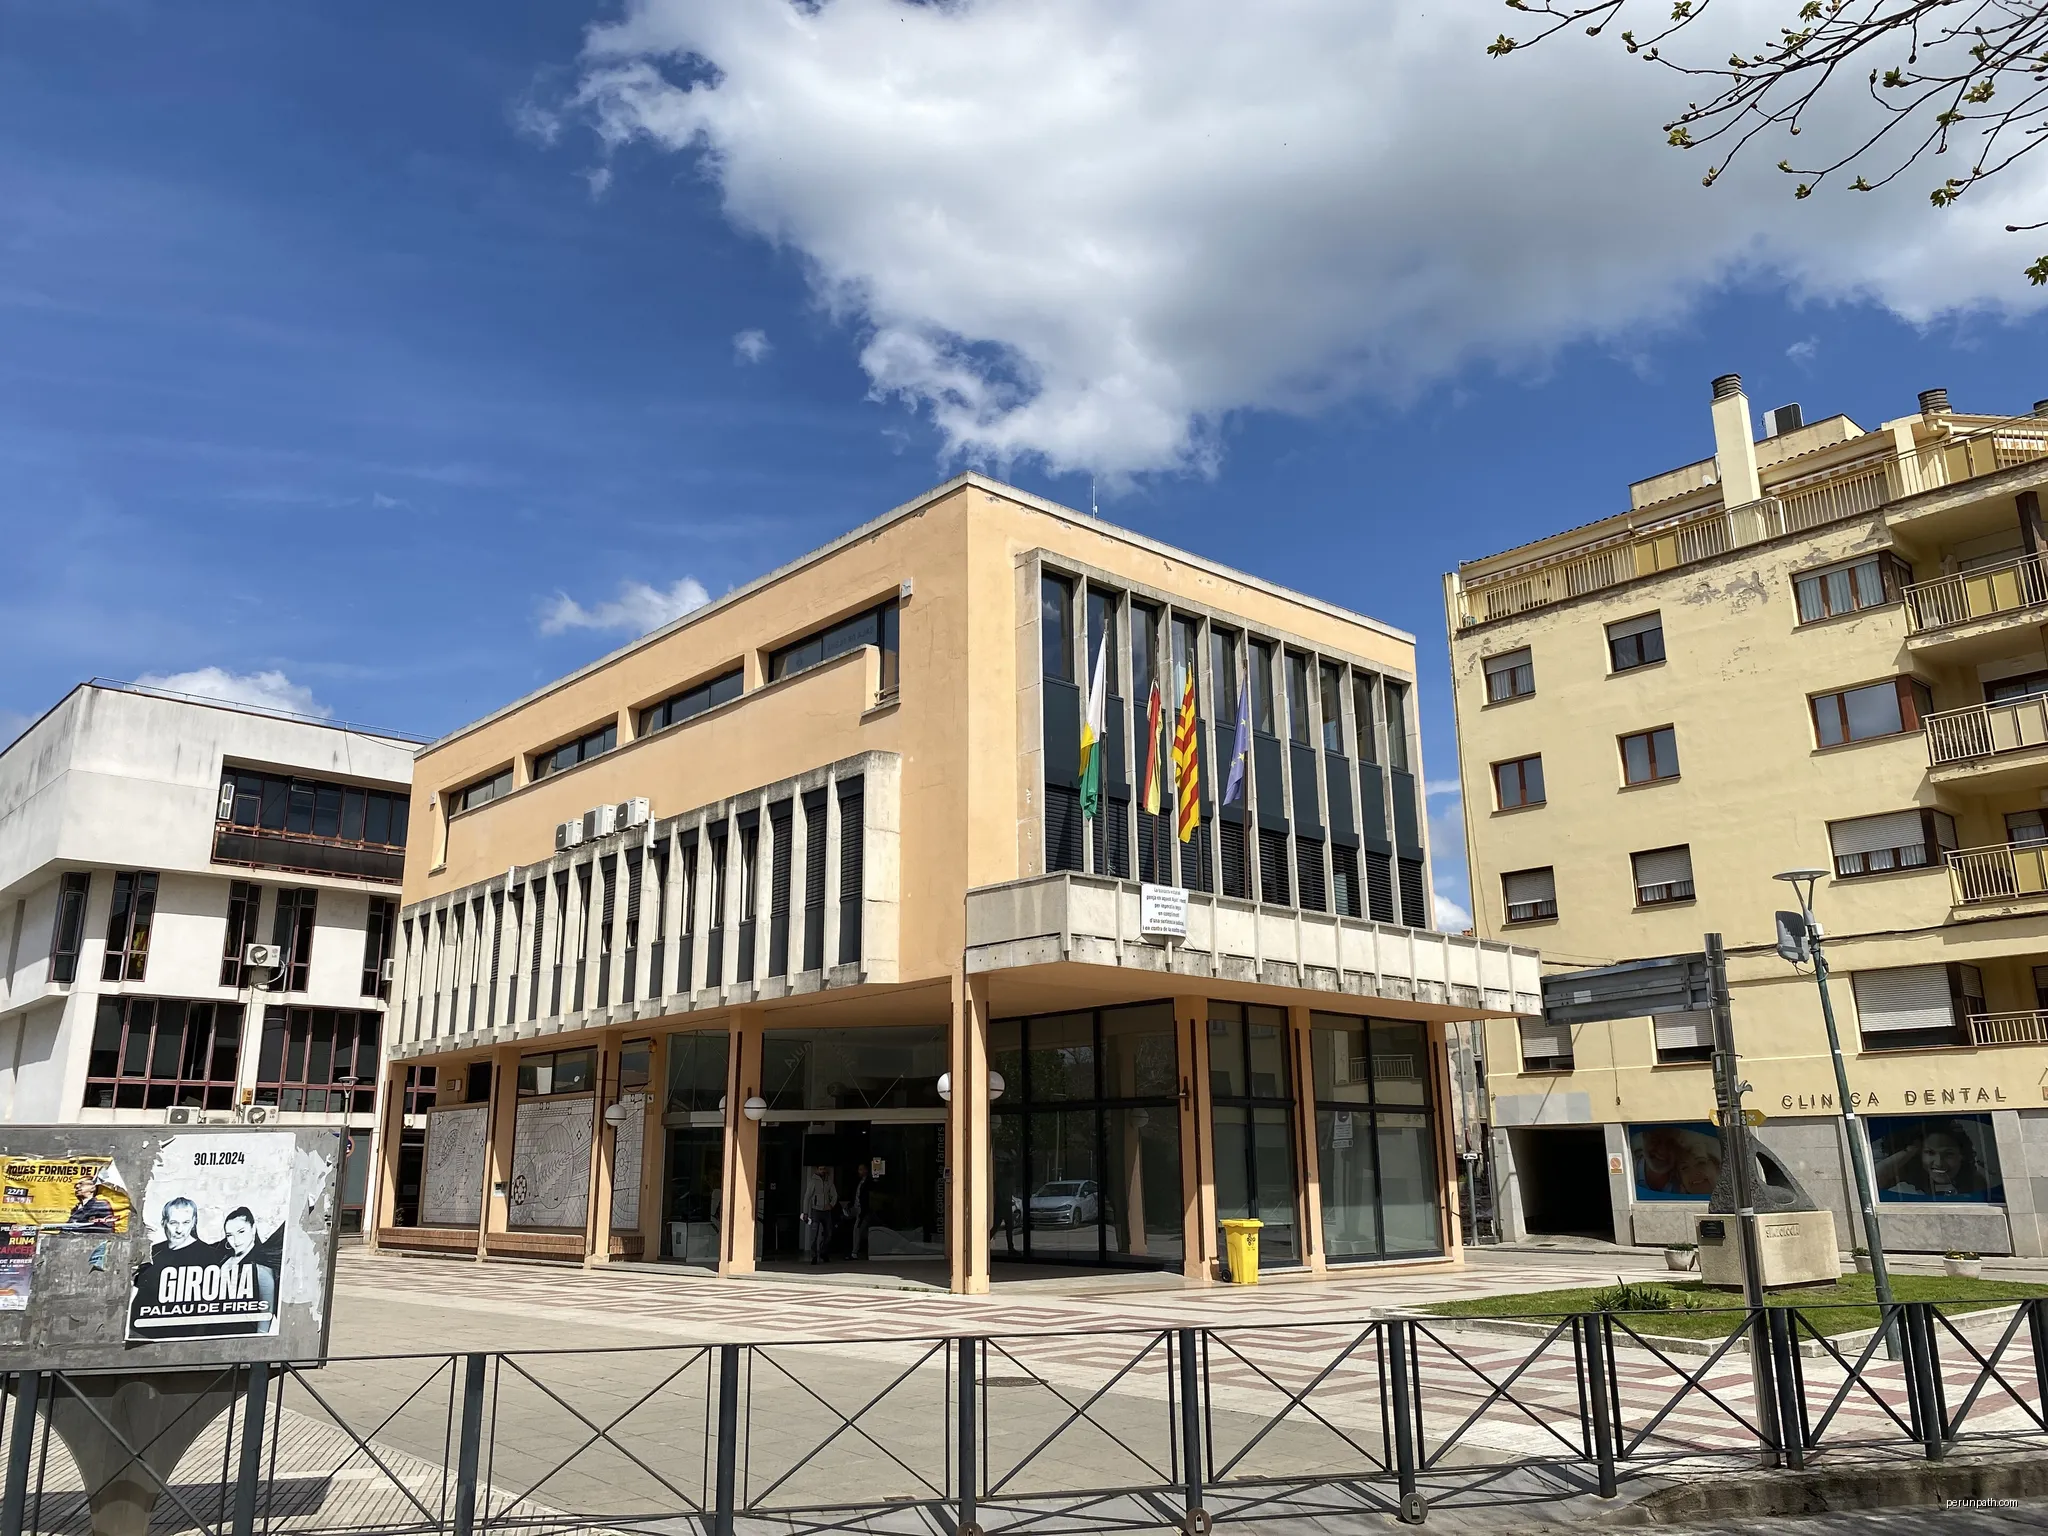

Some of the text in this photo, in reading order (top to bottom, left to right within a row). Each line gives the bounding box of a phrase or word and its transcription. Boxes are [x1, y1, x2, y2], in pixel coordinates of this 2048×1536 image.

[1781, 1086, 2007, 1110] CLINCA DENTAL
[935, 1126, 945, 1163] farners
[194, 1152, 245, 1166] 30.11.2024
[38, 1165, 78, 1176] FORMES
[80, 1166, 93, 1176] DE
[9, 1237, 35, 1246] RUN4
[0, 1246, 34, 1255] ANCER
[158, 1264, 254, 1303] GIRONA
[139, 1300, 269, 1317] PALAU DE FIRES
